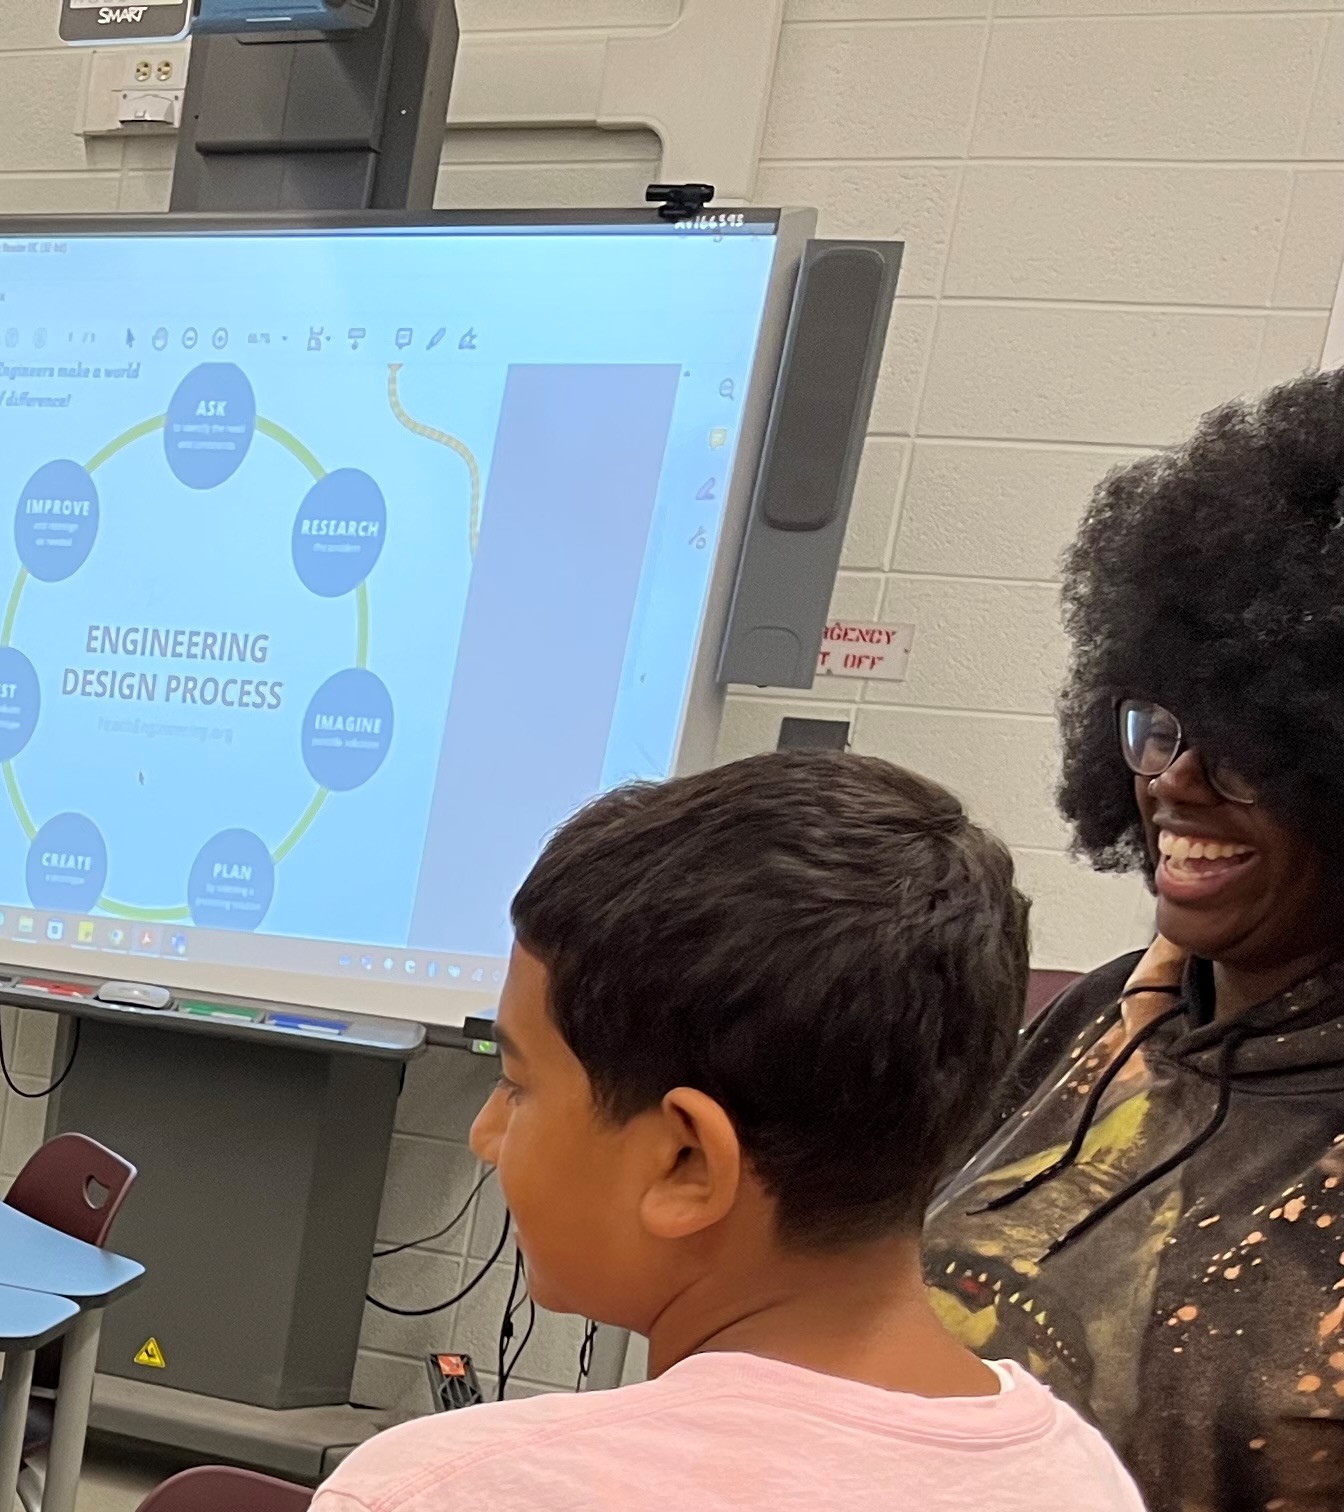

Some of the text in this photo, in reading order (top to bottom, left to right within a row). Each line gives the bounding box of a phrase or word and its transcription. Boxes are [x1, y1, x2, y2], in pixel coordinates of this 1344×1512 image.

[97, 7, 148, 24] SMART
[57, 361, 89, 378] make
[93, 367, 101, 378] a
[104, 361, 142, 379] world
[195, 400, 227, 416] ASK
[25, 498, 91, 516] IMPROVE
[300, 519, 380, 537] RESEARCH
[85, 624, 270, 663] ENGINEERING
[843, 653, 885, 670] OFF
[61, 667, 285, 710] DESIGN PROCESS
[314, 713, 383, 734] IMAGINE
[41, 852, 92, 871] CREATE
[212, 863, 253, 881] PLAN
